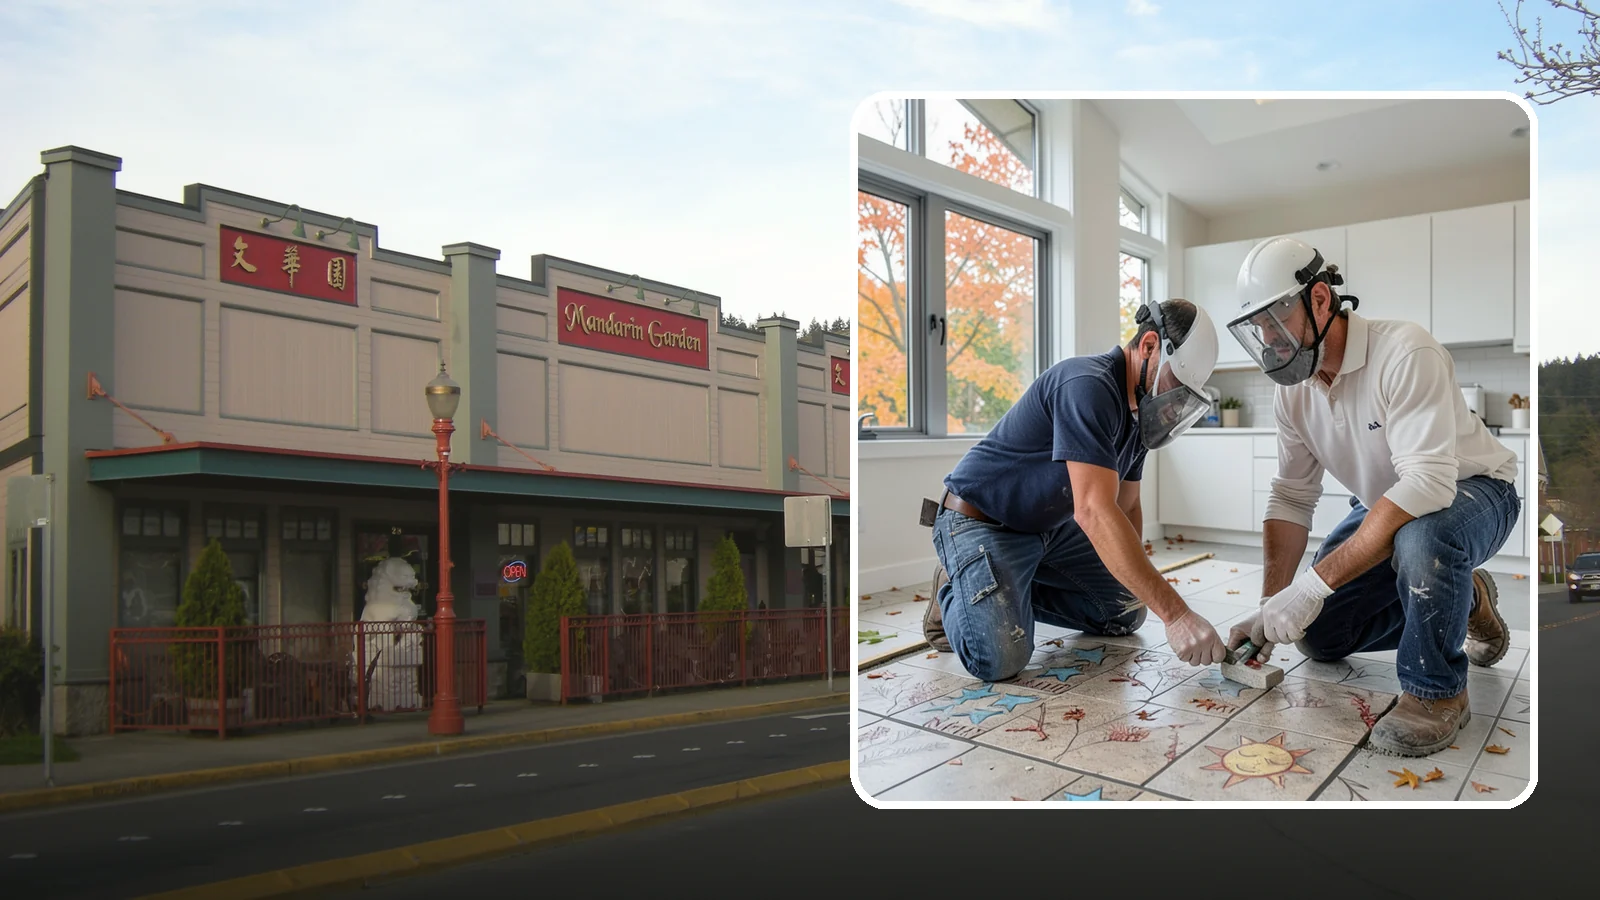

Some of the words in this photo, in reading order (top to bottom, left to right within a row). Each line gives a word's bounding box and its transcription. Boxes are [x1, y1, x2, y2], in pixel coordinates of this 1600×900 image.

[564, 302, 644, 341] Mandarin
[648, 320, 702, 352] Garden
[503, 565, 527, 578] OPEN
